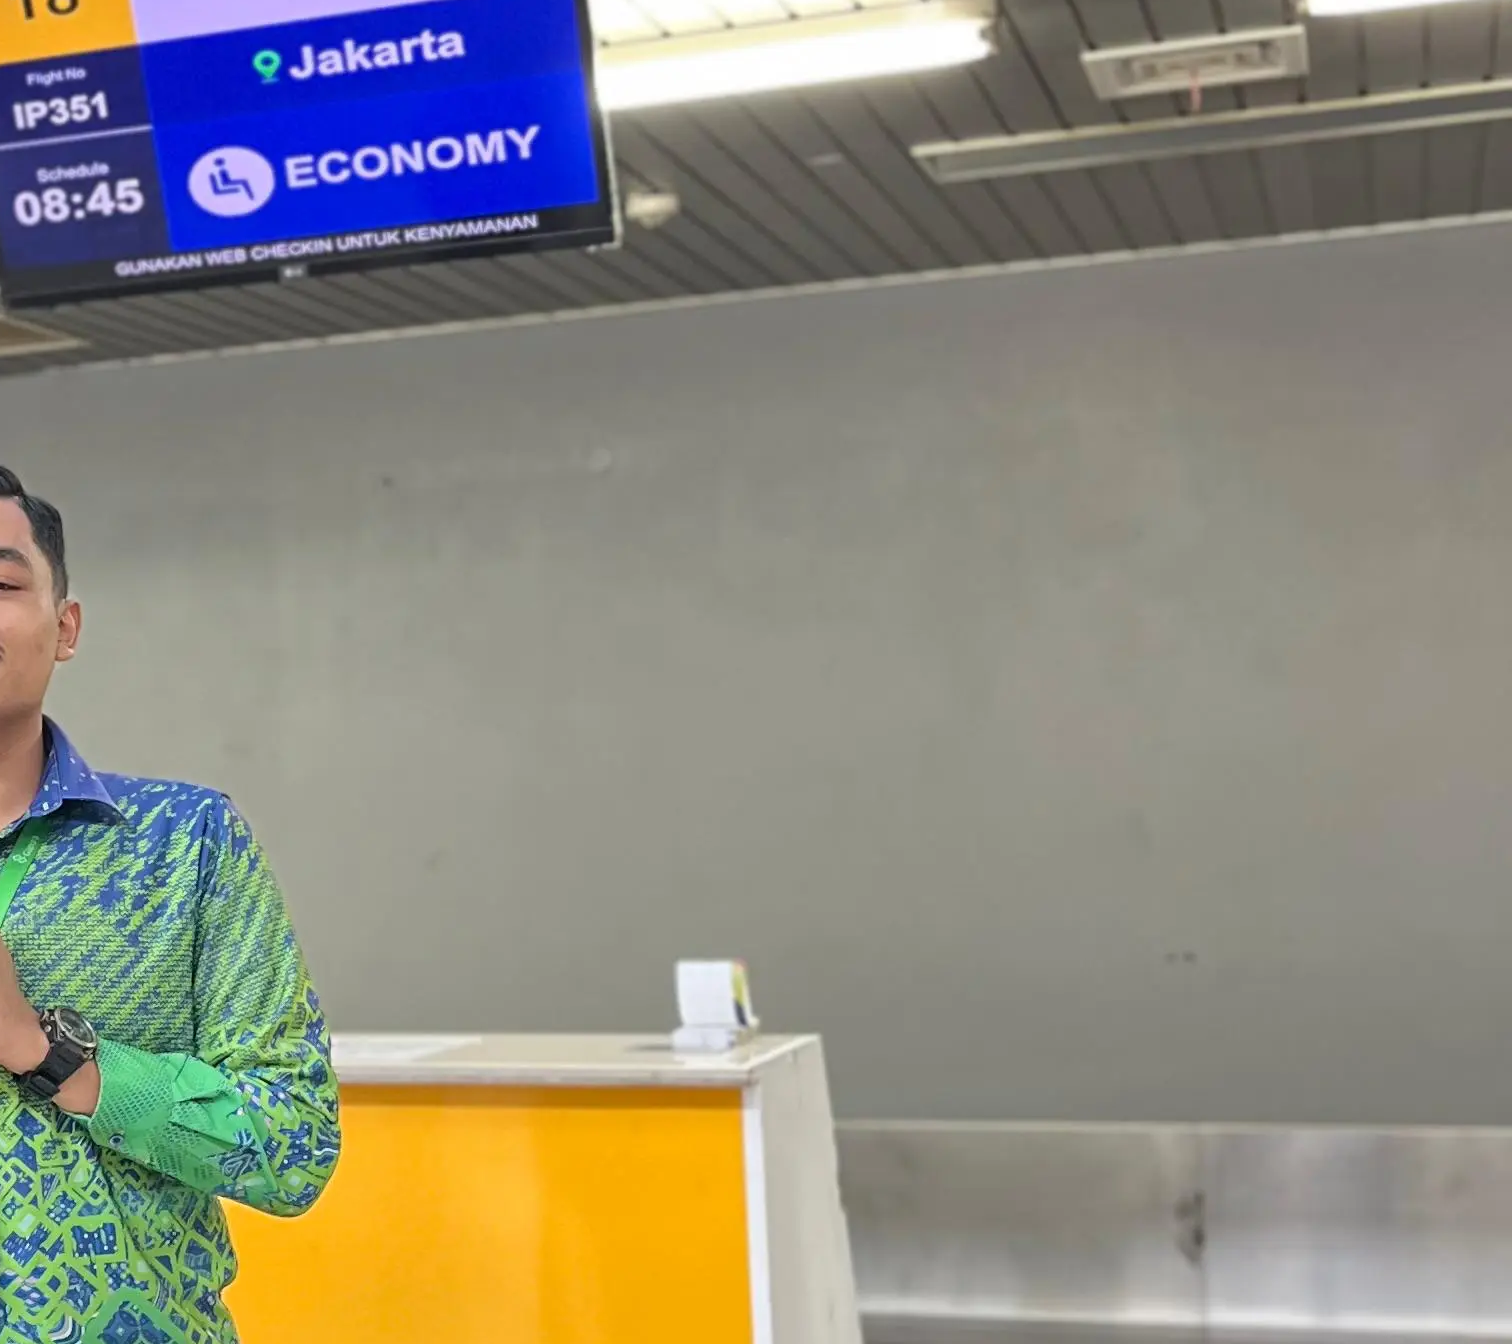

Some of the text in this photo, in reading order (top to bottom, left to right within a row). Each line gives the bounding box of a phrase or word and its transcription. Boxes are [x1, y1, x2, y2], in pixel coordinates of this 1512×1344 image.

[26, 67, 87, 87] Flight No
[289, 29, 466, 80] Jakarta
[12, 91, 109, 130] IP351
[36, 161, 110, 183] Schedule
[284, 125, 540, 189] ECONOMY
[14, 178, 144, 226] 08:45
[114, 214, 538, 277] GUNAKAN WEB CHECKIN UNTUK KENYAMANAN
